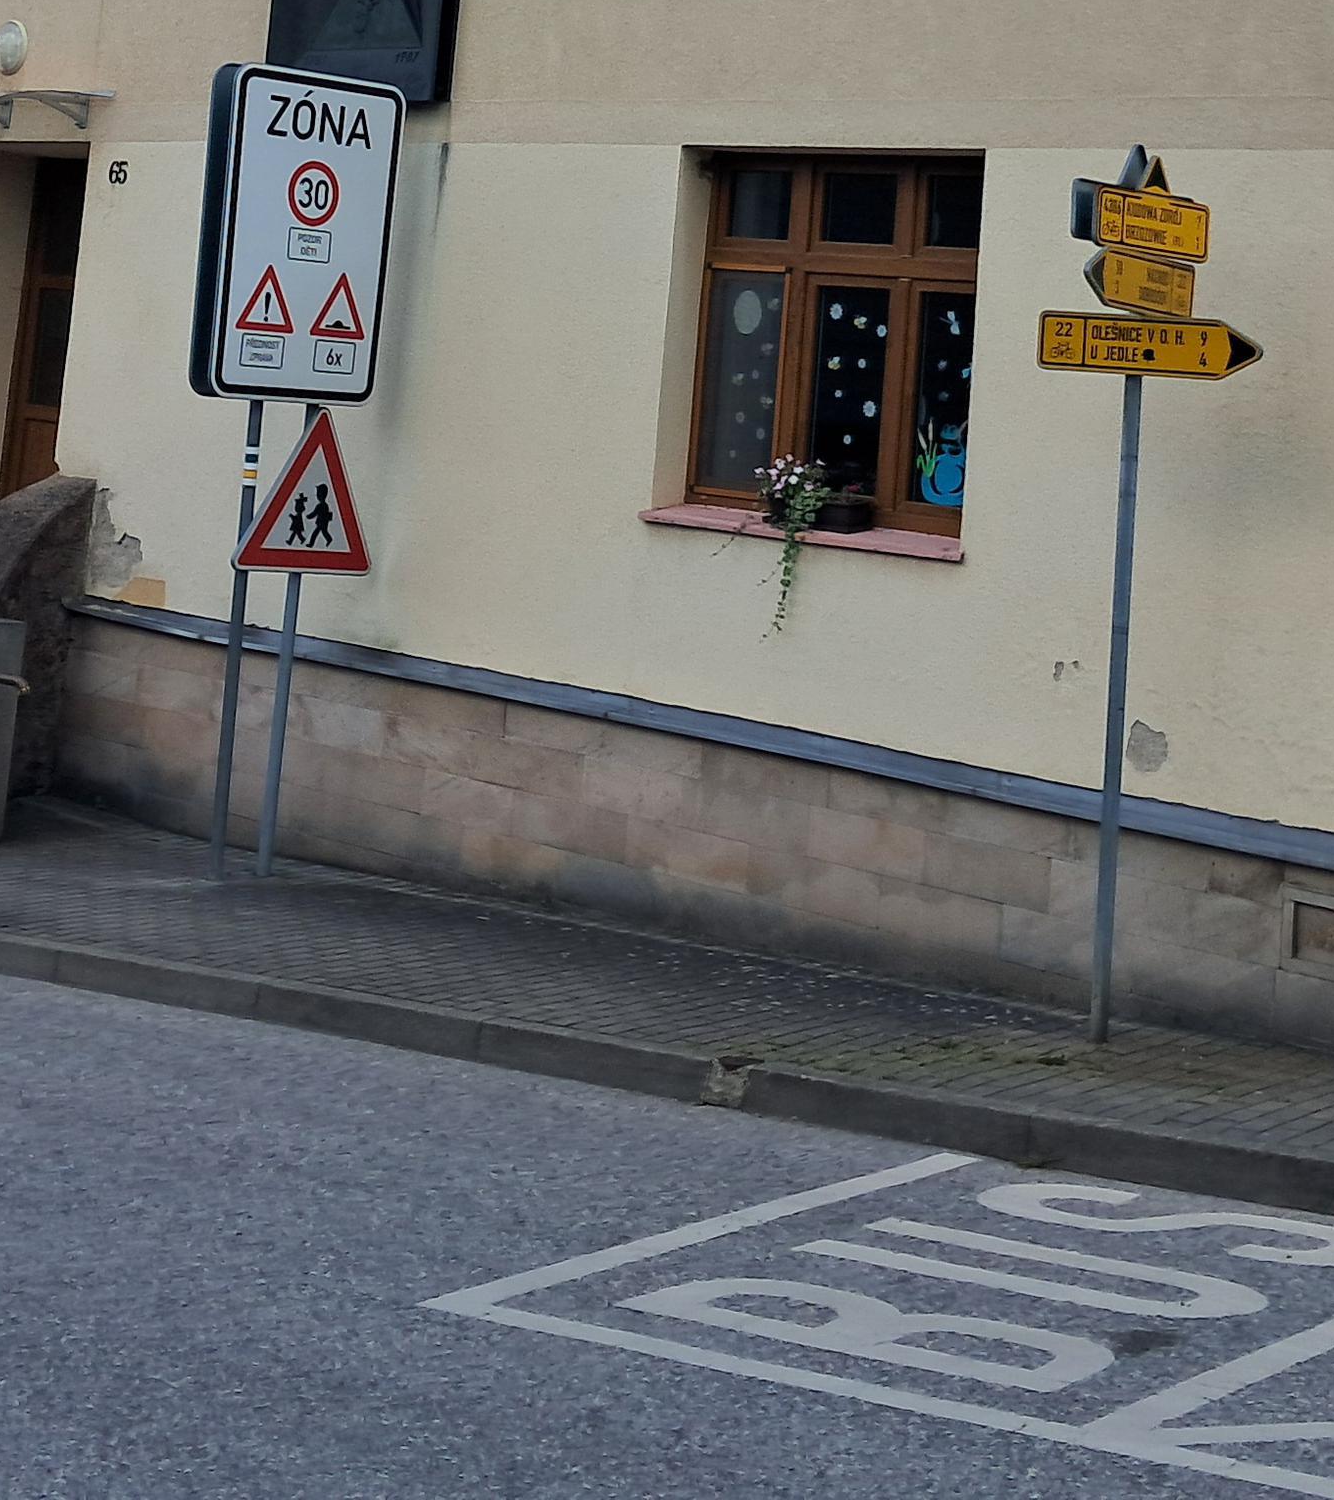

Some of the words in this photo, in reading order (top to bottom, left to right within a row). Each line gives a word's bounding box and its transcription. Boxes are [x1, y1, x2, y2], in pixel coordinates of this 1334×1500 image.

[266, 90, 372, 150] ZÓNA
[109, 160, 129, 185] 65
[298, 177, 330, 211] 30
[1054, 321, 1074, 338] 22
[1090, 322, 1143, 343] OLEŠNICE
[1147, 330, 1156, 344] V
[1159, 331, 1169, 346] O.
[1174, 331, 1186, 346] H.
[1199, 332, 1209, 347] 9
[325, 348, 344, 368] 6x
[1090, 346, 1099, 360] U
[1103, 346, 1139, 363] JEDLE
[1198, 352, 1208, 368] 4
